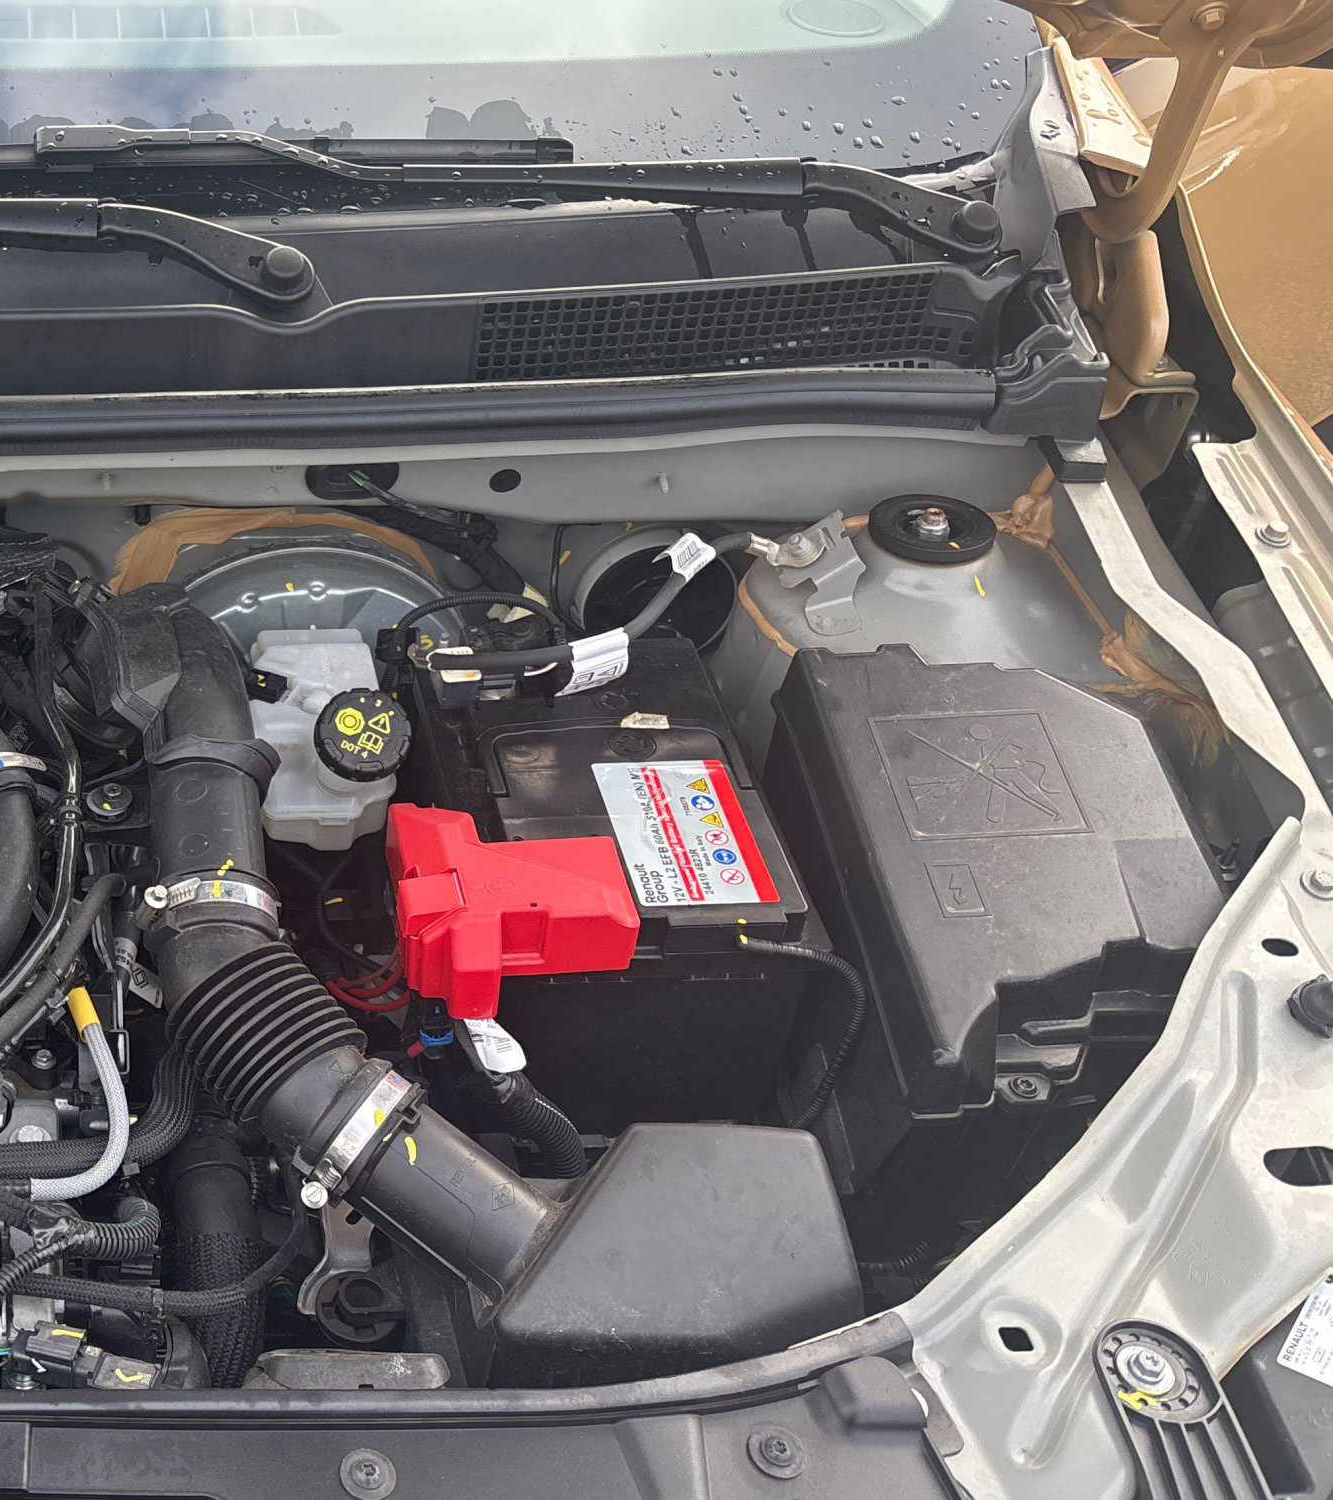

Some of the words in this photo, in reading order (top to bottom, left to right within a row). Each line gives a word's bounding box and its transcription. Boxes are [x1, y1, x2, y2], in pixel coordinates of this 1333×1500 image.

[340, 740, 362, 755] DOT
[361, 750, 369, 759] 4
[633, 782, 647, 800] (EN)
[649, 823, 665, 845] 60Ah
[666, 821, 679, 845] Battery
[696, 835, 704, 846] Italy
[658, 846, 673, 866] EFB
[702, 853, 712, 867] Made
[665, 867, 678, 879] L2
[633, 863, 658, 904] Renault
[650, 870, 669, 904] Group
[698, 873, 715, 895] 24410
[671, 886, 687, 902] 12V
[1282, 1321, 1309, 1362] RENAULT
